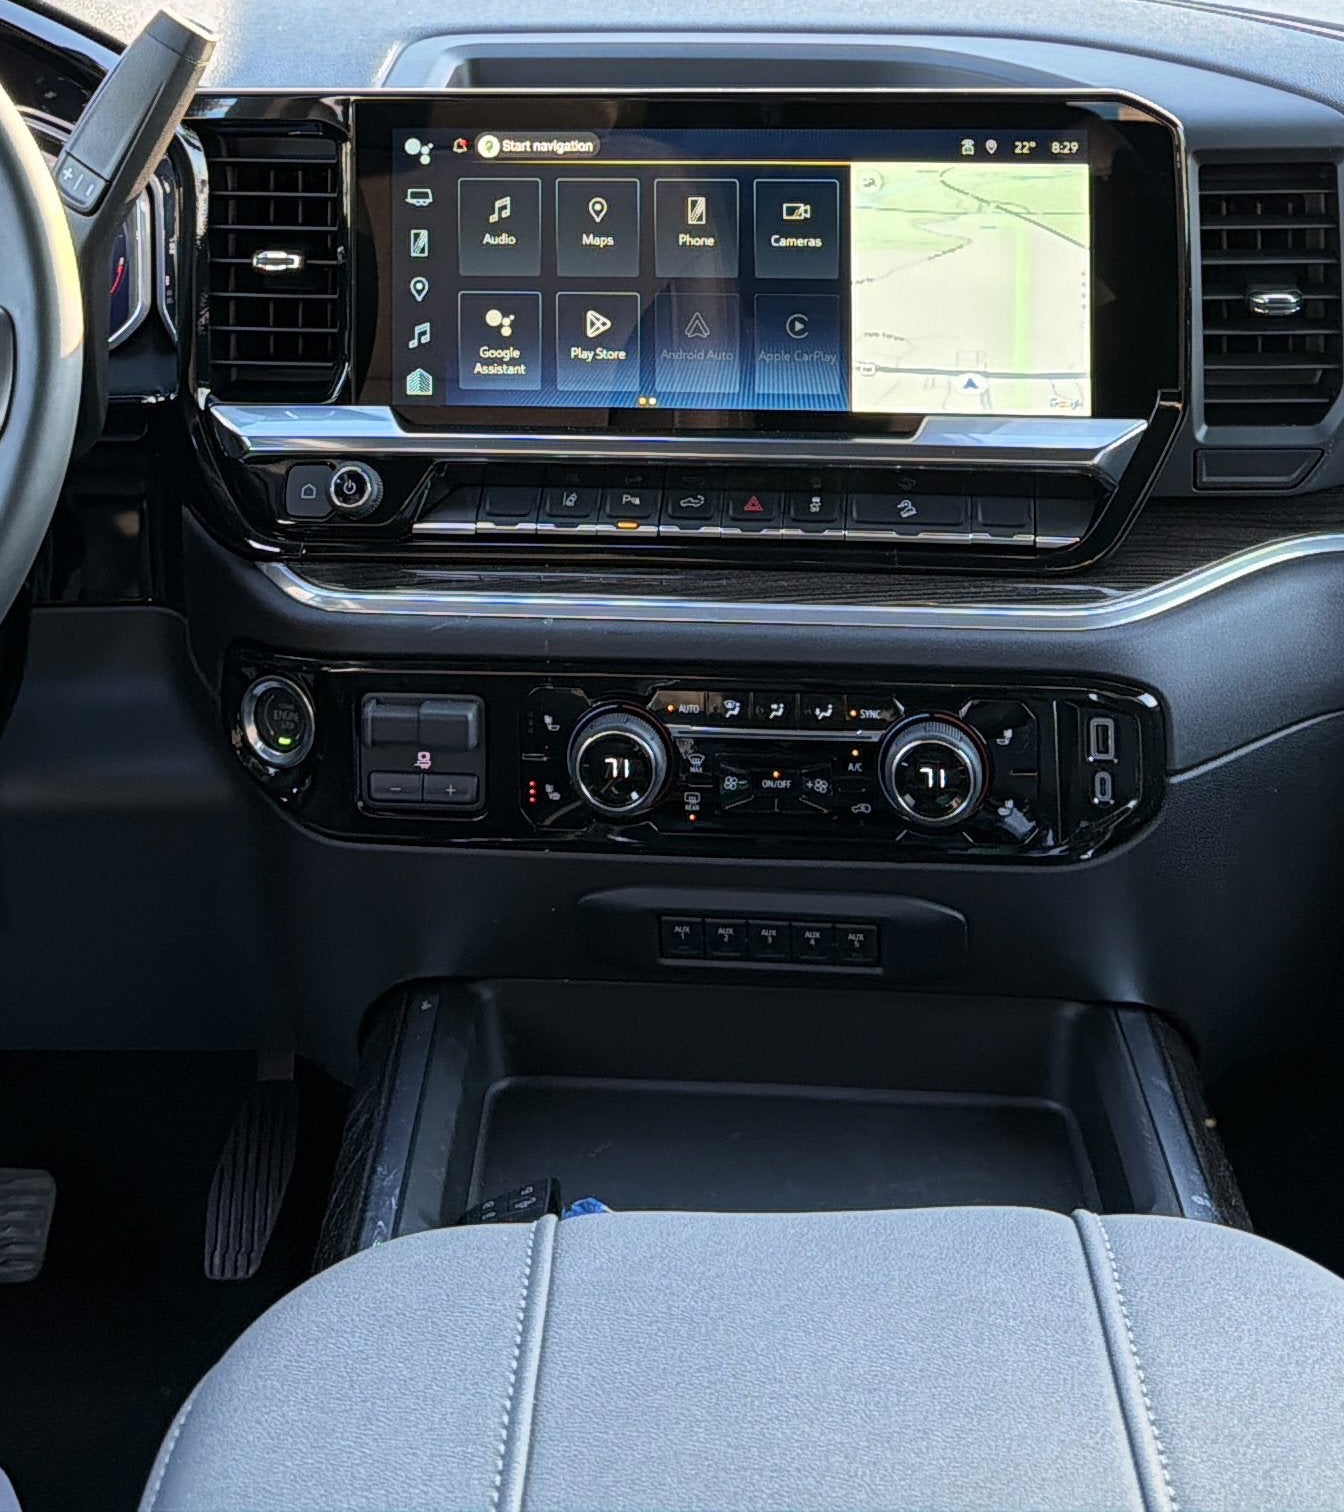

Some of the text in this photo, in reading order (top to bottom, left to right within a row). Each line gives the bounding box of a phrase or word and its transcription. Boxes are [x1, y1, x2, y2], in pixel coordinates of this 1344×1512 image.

[502, 140, 594, 155] Start navigation
[1051, 141, 1078, 154] 8:29
[483, 233, 516, 245] Audio
[582, 234, 614, 248] Maps
[679, 234, 715, 246] Phone
[771, 235, 822, 247] Cameras
[480, 346, 520, 361] Google
[570, 347, 626, 362] Play Store
[660, 349, 734, 361] Android Auto
[759, 350, 837, 364] Apple CarPlay
[474, 363, 526, 375] Assistant
[678, 705, 699, 714] AUTO
[860, 709, 881, 719] SYNC
[604, 758, 629, 778] 71
[848, 763, 862, 772] A/C
[919, 767, 945, 788] 71
[762, 780, 792, 789] ON/OFF
